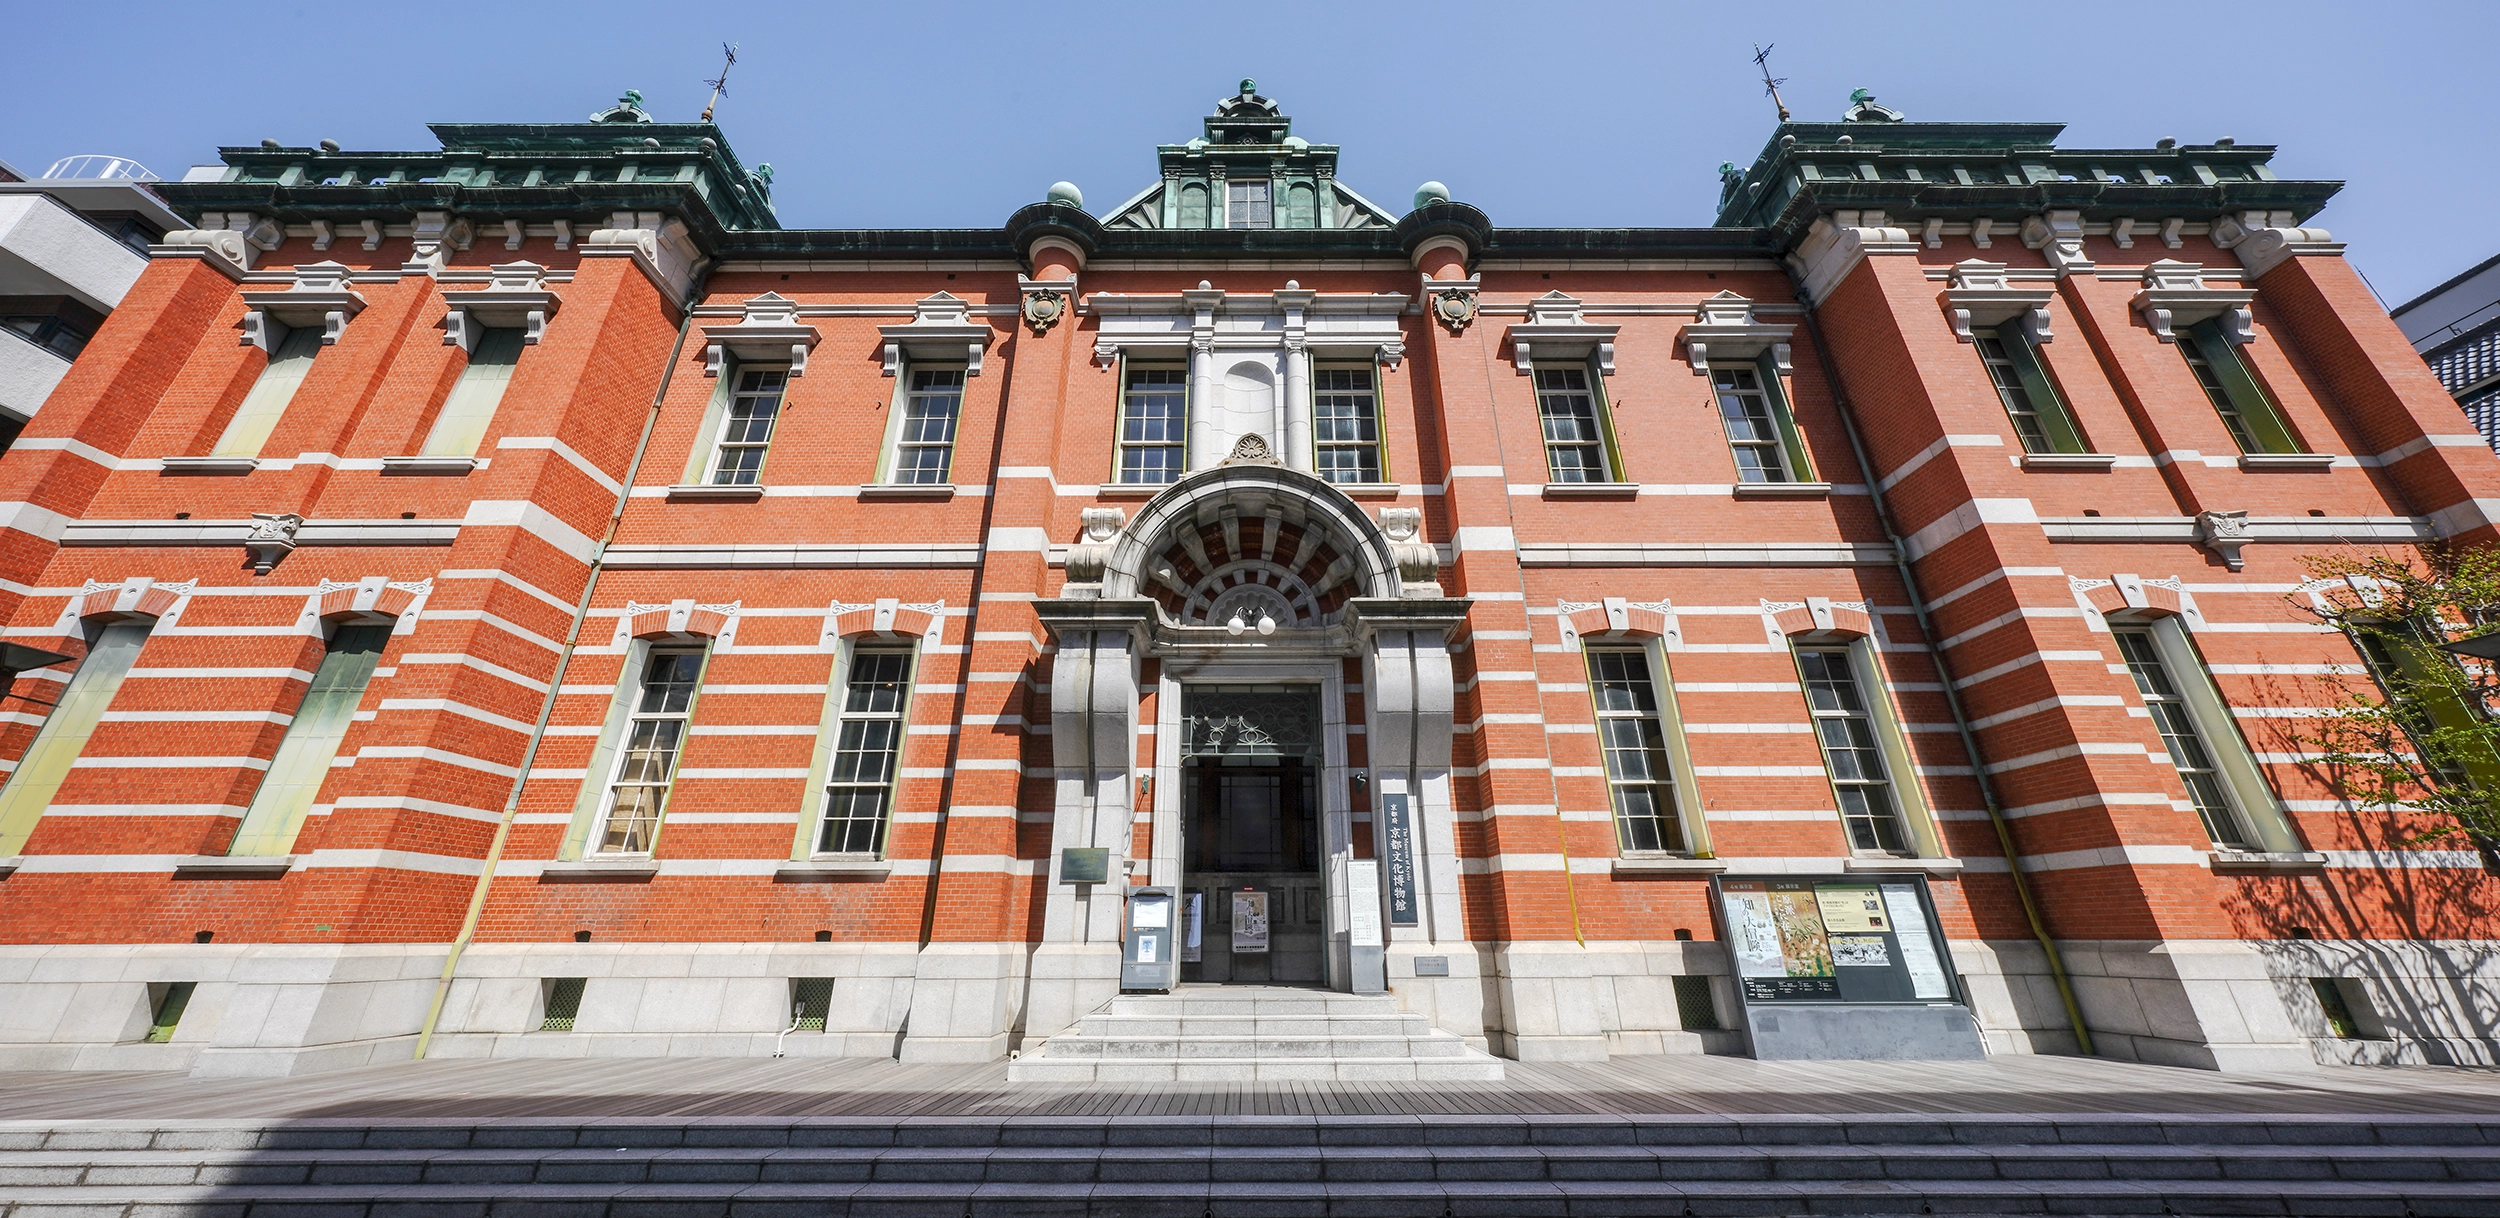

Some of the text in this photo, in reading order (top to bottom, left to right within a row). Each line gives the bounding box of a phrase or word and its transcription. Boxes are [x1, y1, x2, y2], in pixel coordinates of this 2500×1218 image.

[1390, 827, 1407, 912] 京都文化博物館
[1743, 898, 1763, 952] 知の大冒険
